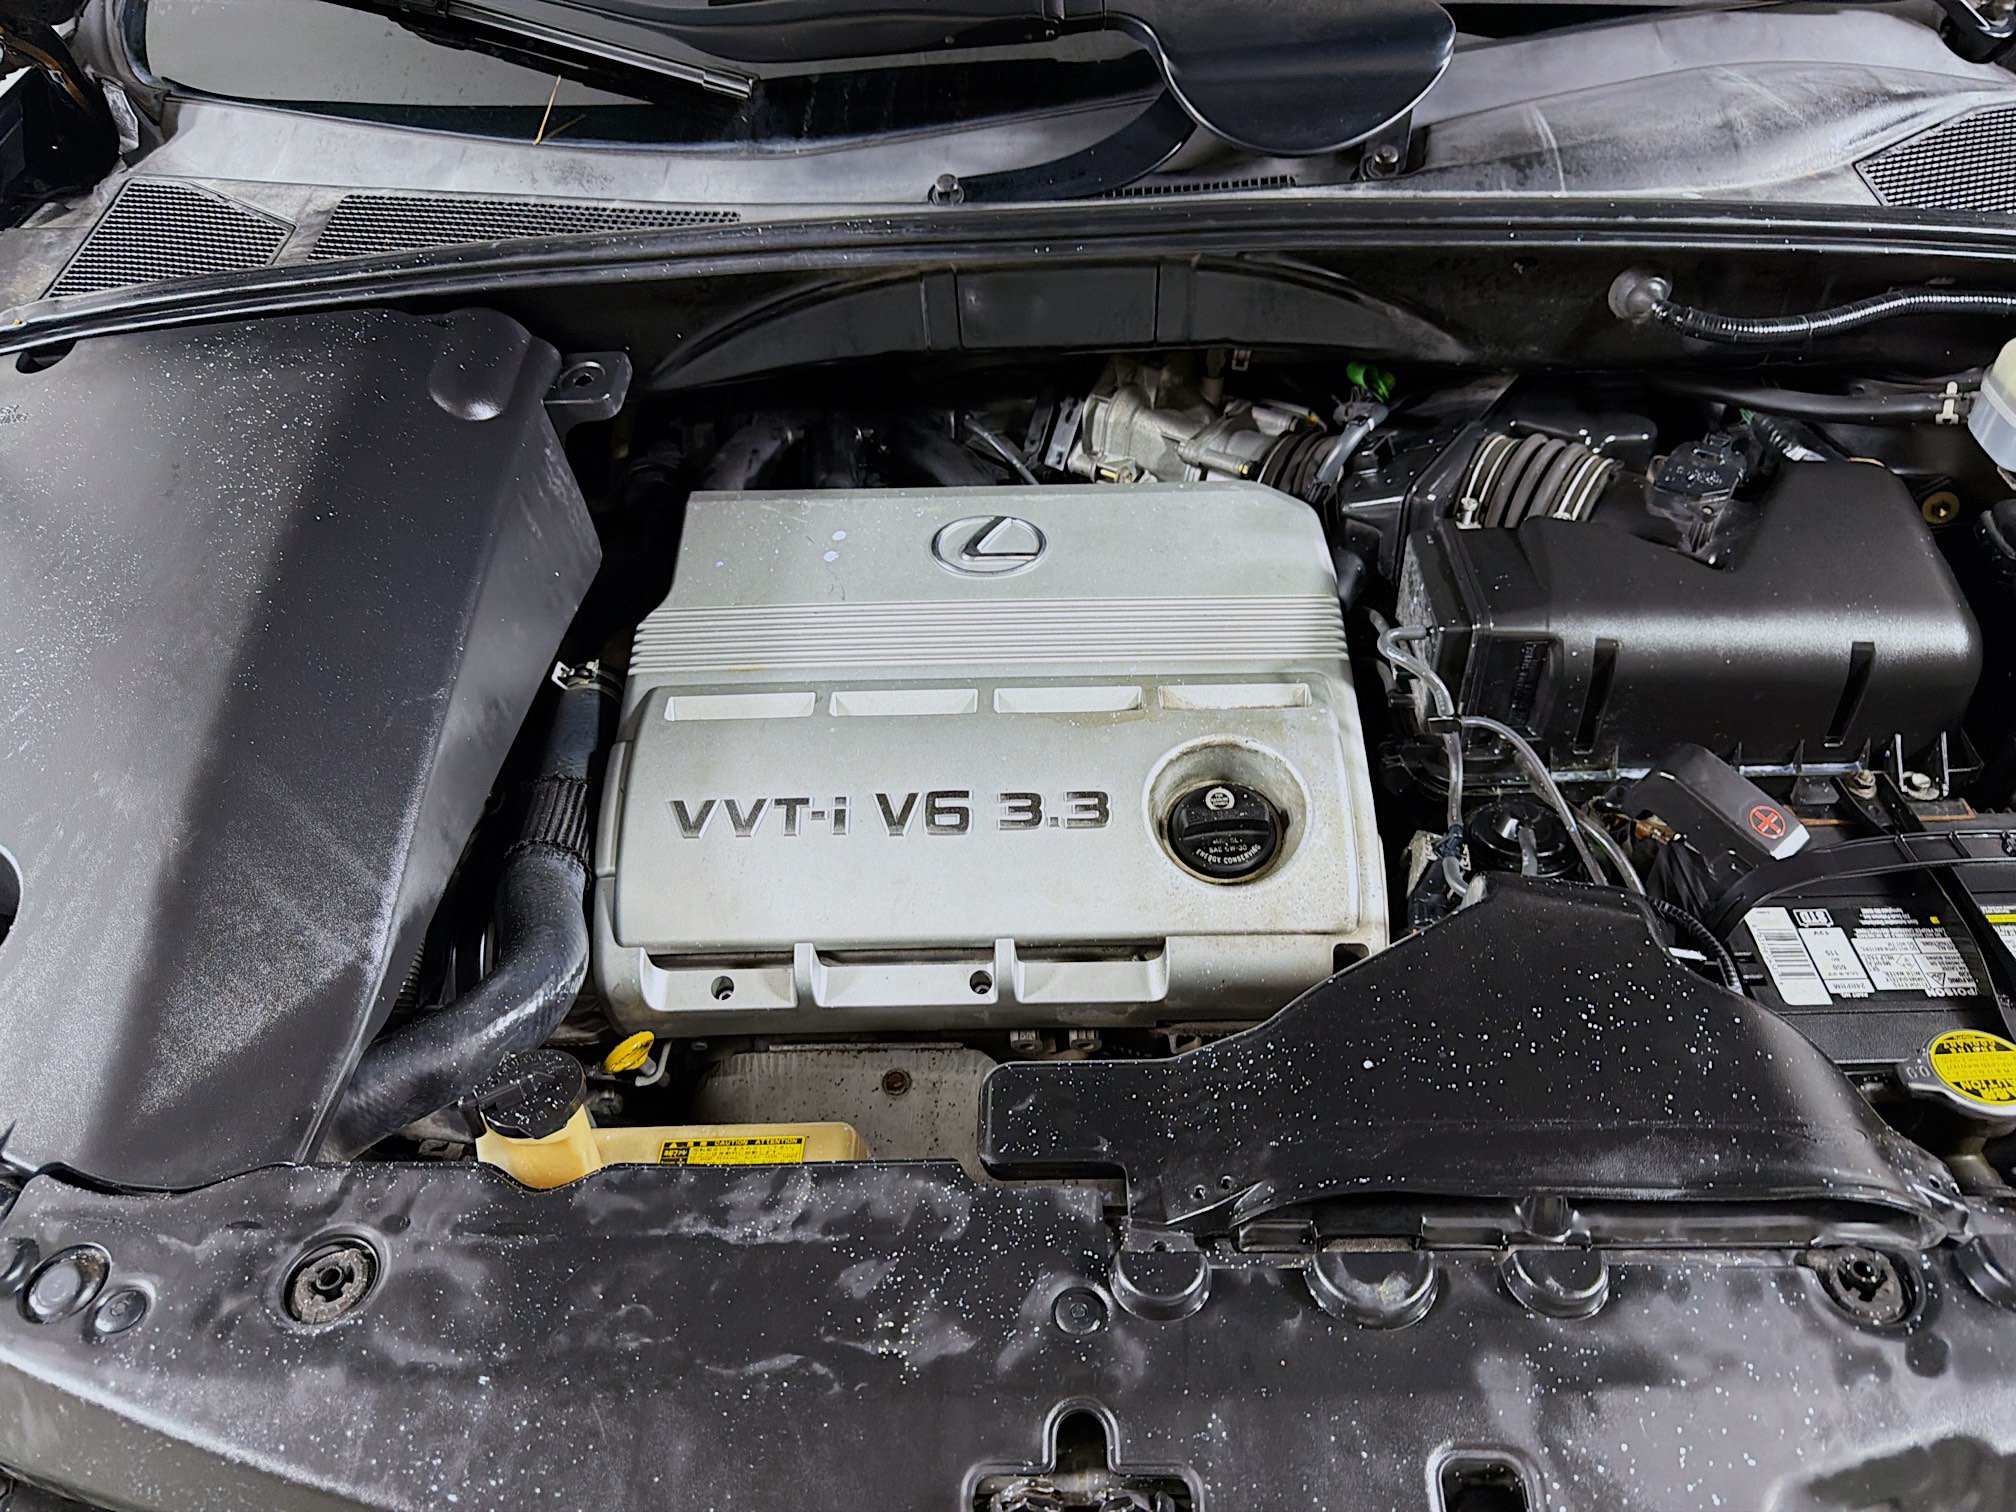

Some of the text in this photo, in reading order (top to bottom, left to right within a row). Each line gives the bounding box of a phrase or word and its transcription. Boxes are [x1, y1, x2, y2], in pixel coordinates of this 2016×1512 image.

[668, 790, 1113, 839] VVT-i V6 3.3
[1195, 843, 1262, 865] ENERGY CONSERVING
